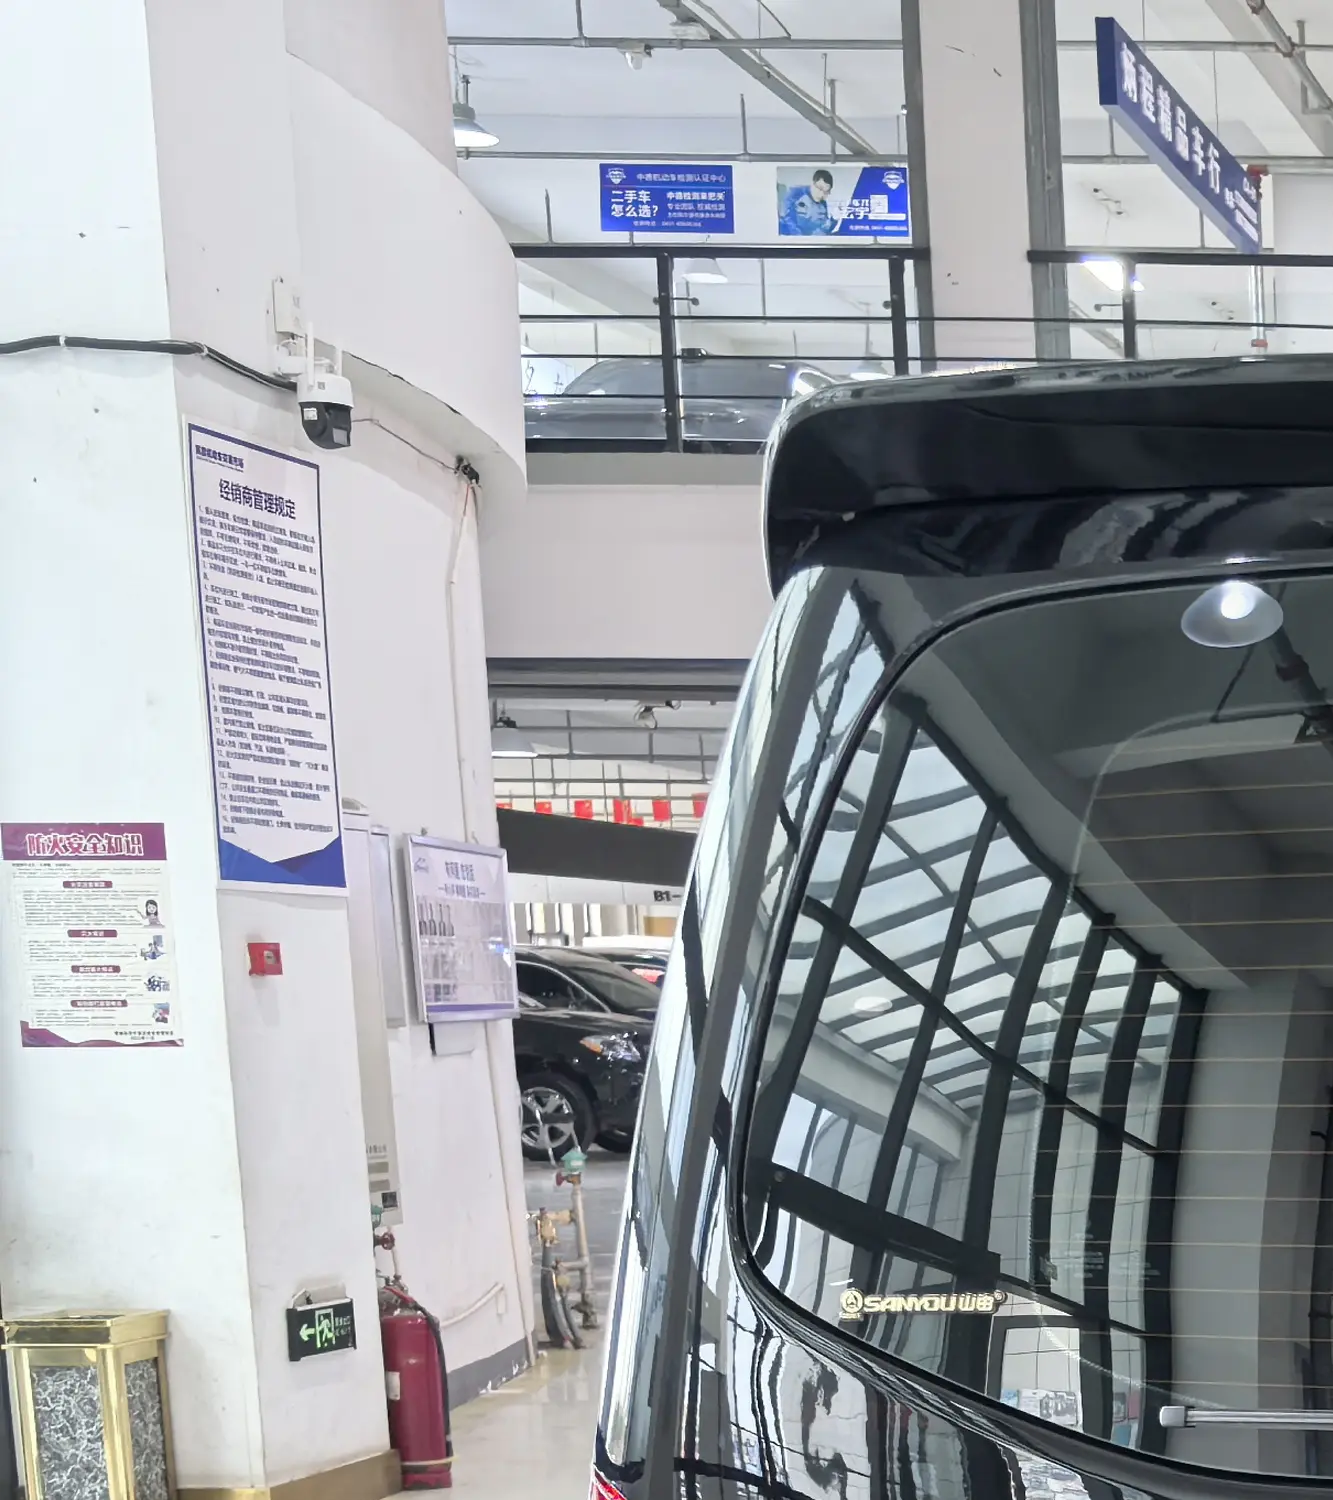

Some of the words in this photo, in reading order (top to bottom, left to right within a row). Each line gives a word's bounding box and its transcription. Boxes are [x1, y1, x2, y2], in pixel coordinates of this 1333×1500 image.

[611, 190, 651, 203] 二手车
[219, 478, 296, 519] 经销商管理规定
[26, 833, 144, 856] 防火安全知识
